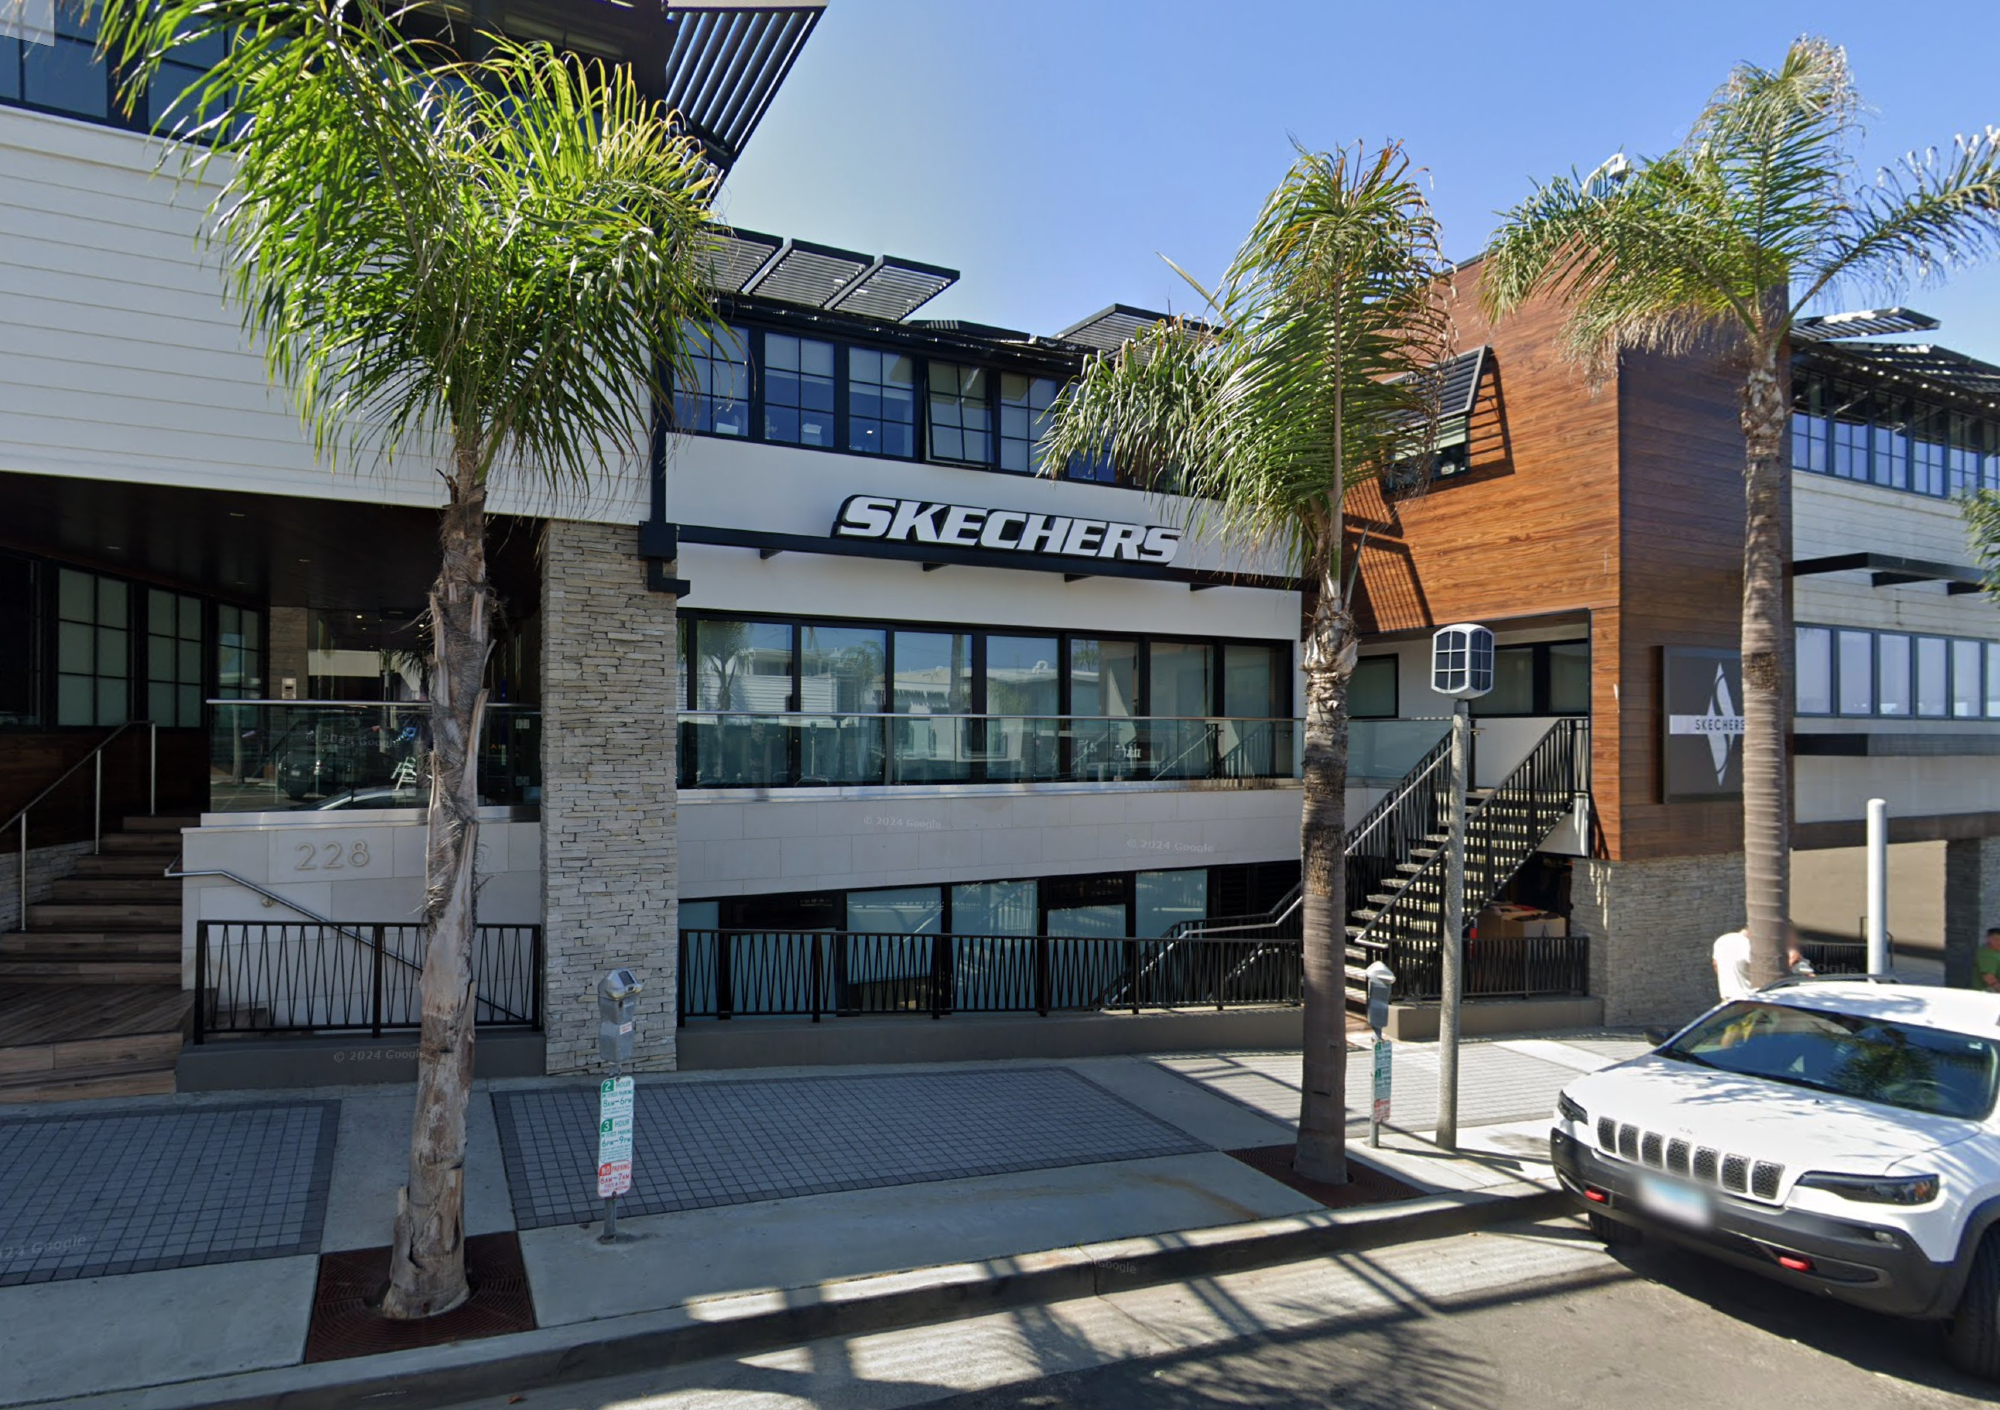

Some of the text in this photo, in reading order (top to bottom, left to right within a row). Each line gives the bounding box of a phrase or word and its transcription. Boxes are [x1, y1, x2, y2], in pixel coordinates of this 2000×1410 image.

[836, 495, 1182, 564] SKECHERS
[1694, 718, 1745, 731] SKECHERS
[294, 841, 369, 871] 228
[604, 1080, 632, 1092] 2 HOUR
[604, 1119, 630, 1131] 3 HOUR
[602, 1164, 630, 1175] NO PARKING
